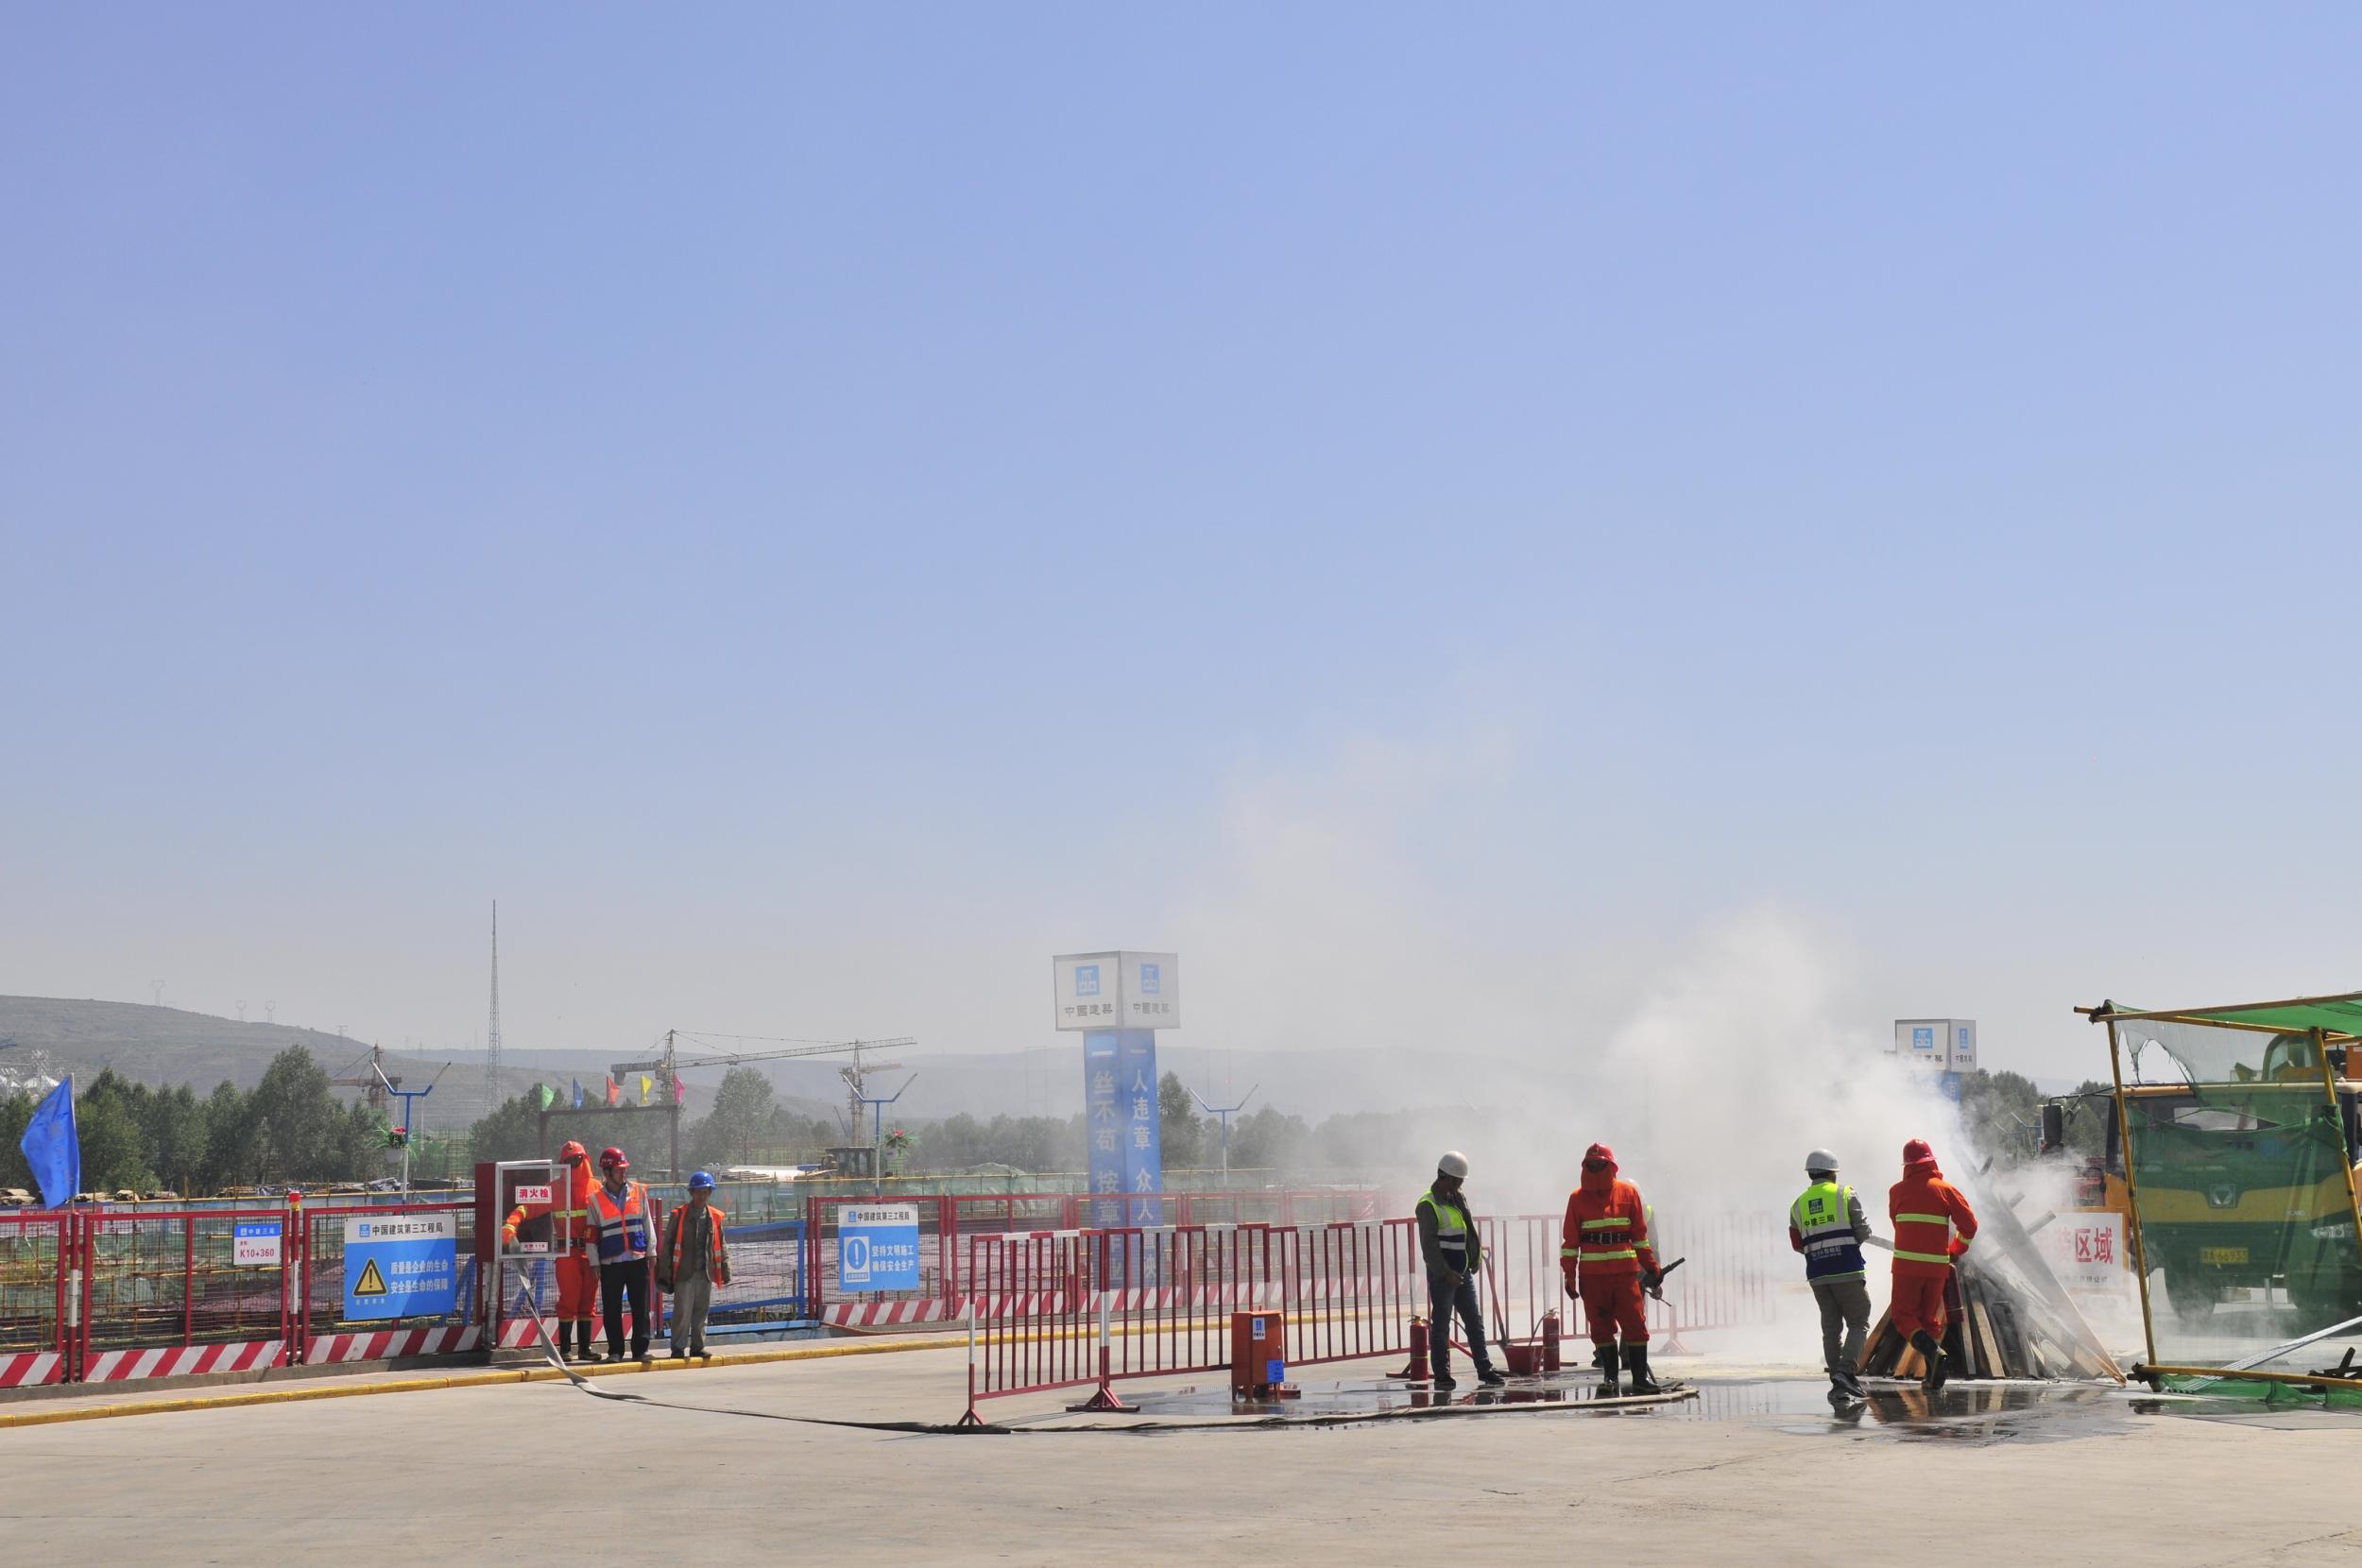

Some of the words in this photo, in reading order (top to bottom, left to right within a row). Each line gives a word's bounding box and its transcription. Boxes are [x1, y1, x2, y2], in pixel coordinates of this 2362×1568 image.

[519, 1188, 549, 1198] 消火栓
[858, 1211, 910, 1221] 中国建筑第三工程局
[1804, 1215, 1835, 1227] 中建三局
[372, 1222, 443, 1236] 中国建筑第三工程局
[240, 1248, 275, 1258] K10+360
